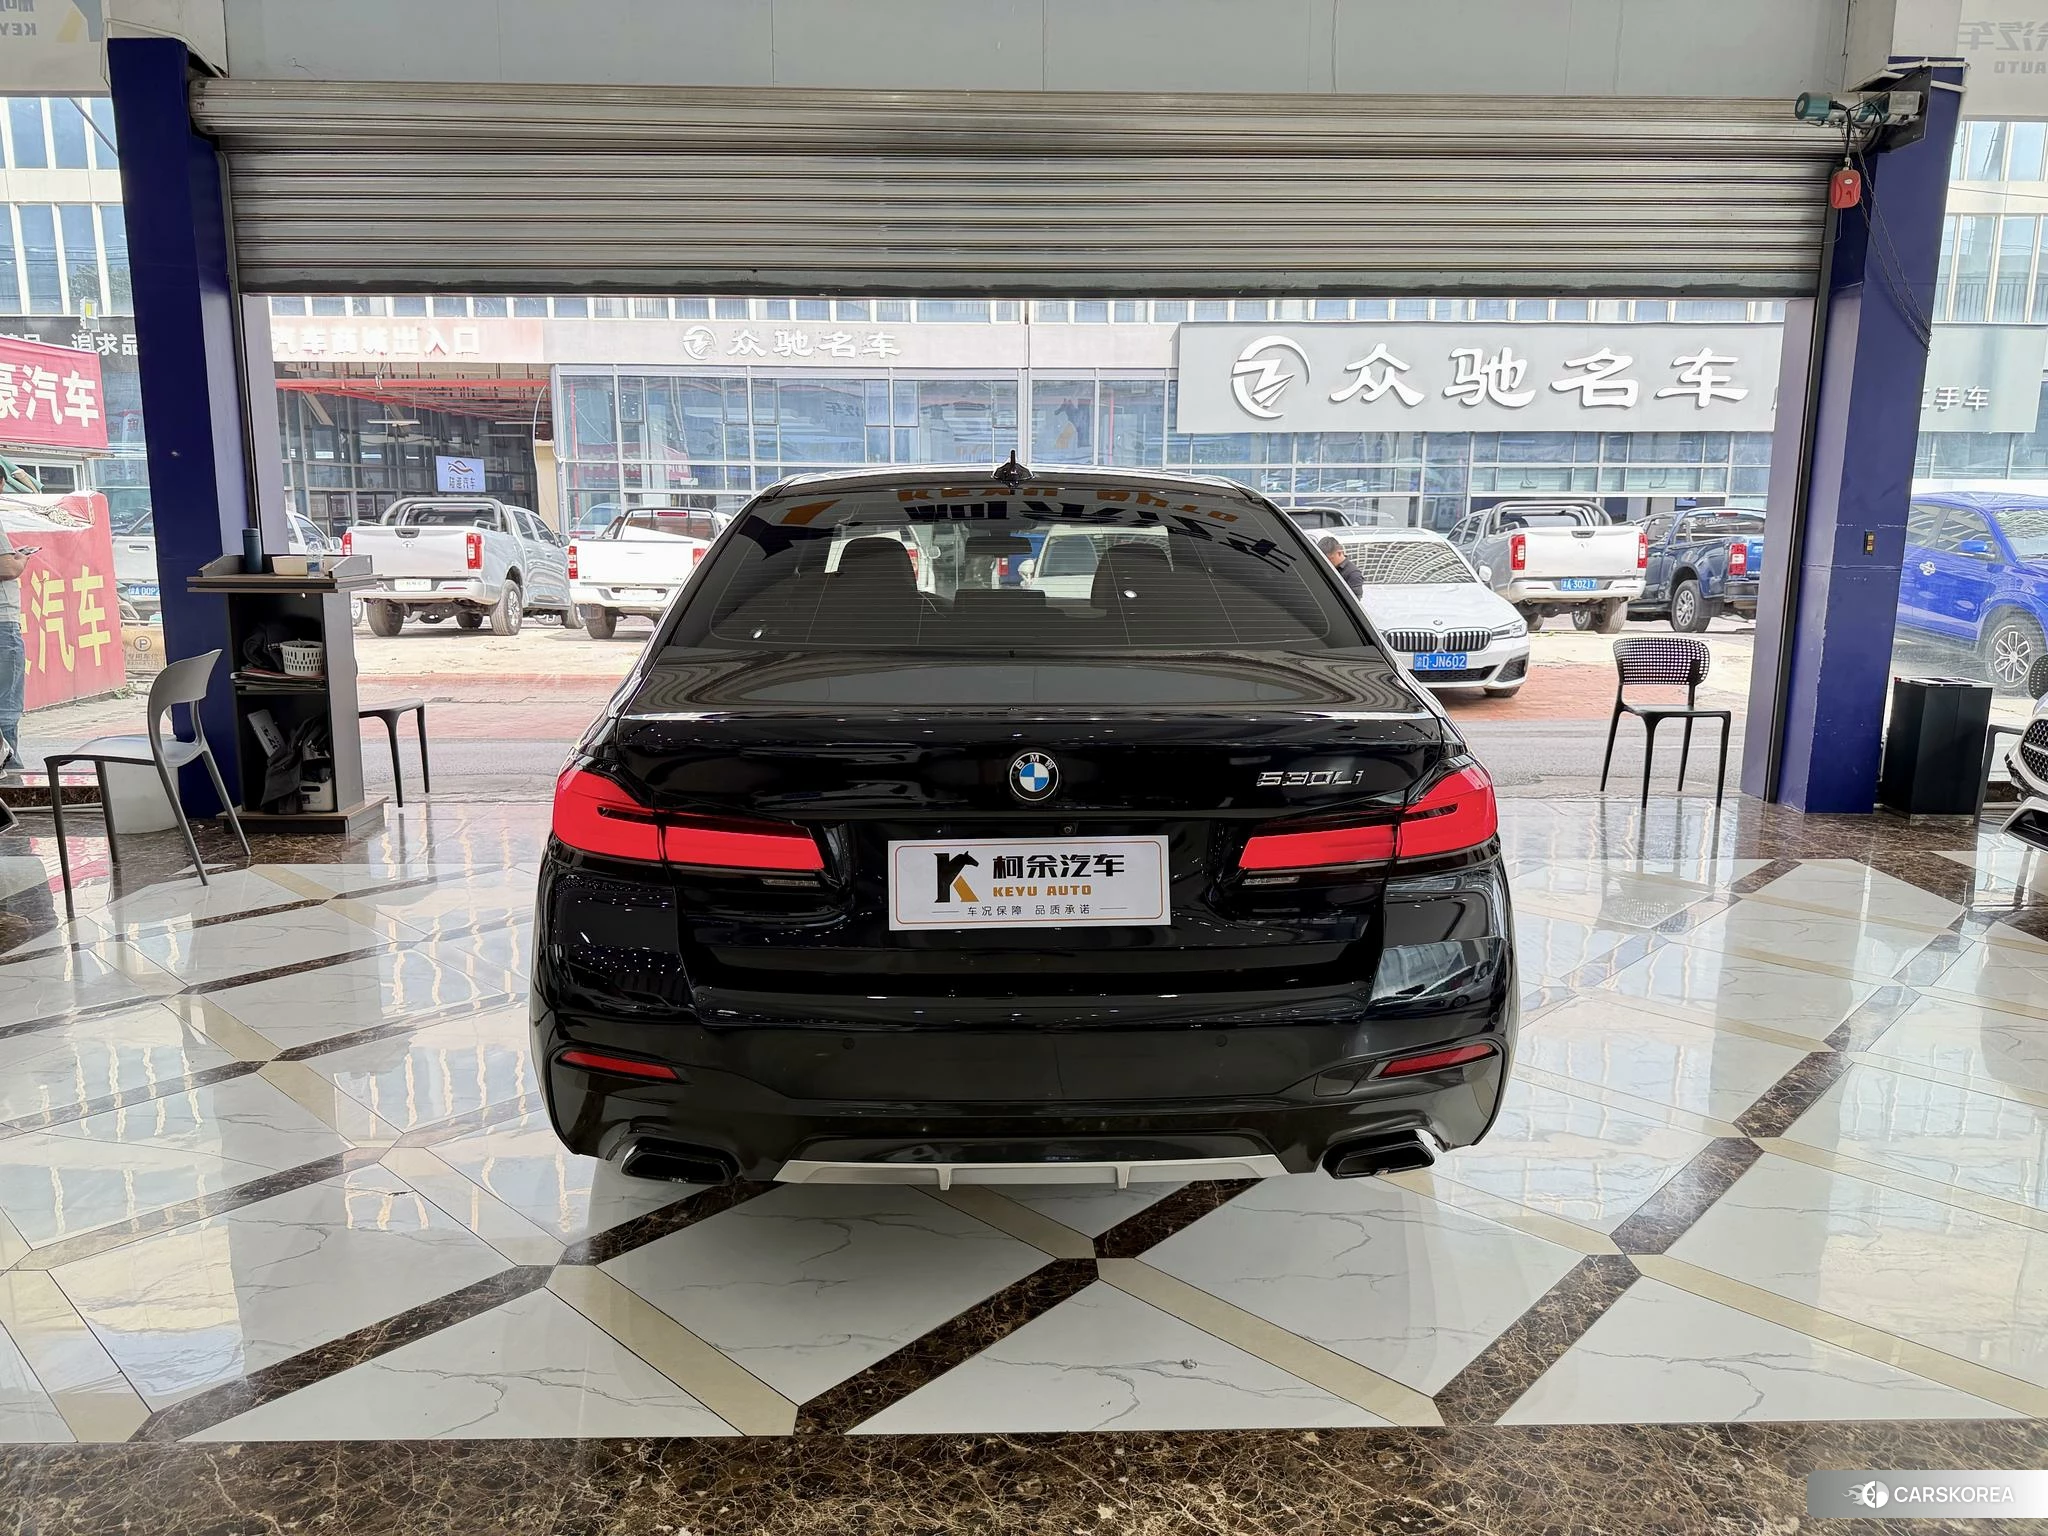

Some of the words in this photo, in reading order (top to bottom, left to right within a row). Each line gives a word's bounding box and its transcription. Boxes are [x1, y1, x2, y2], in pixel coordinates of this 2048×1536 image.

[727, 329, 901, 359] 众驰名车
[1329, 342, 1749, 409] 众驰名车
[18, 565, 111, 674] 汽车
[1015, 754, 1055, 770] BMW
[1256, 771, 1364, 787] 530Li
[992, 853, 1125, 879] 柯余汽车
[992, 885, 1038, 897] KEYU
[1047, 884, 1092, 896] AUTO
[967, 905, 1023, 917] 车况保障
[1035, 903, 1091, 916] 品质承诺
